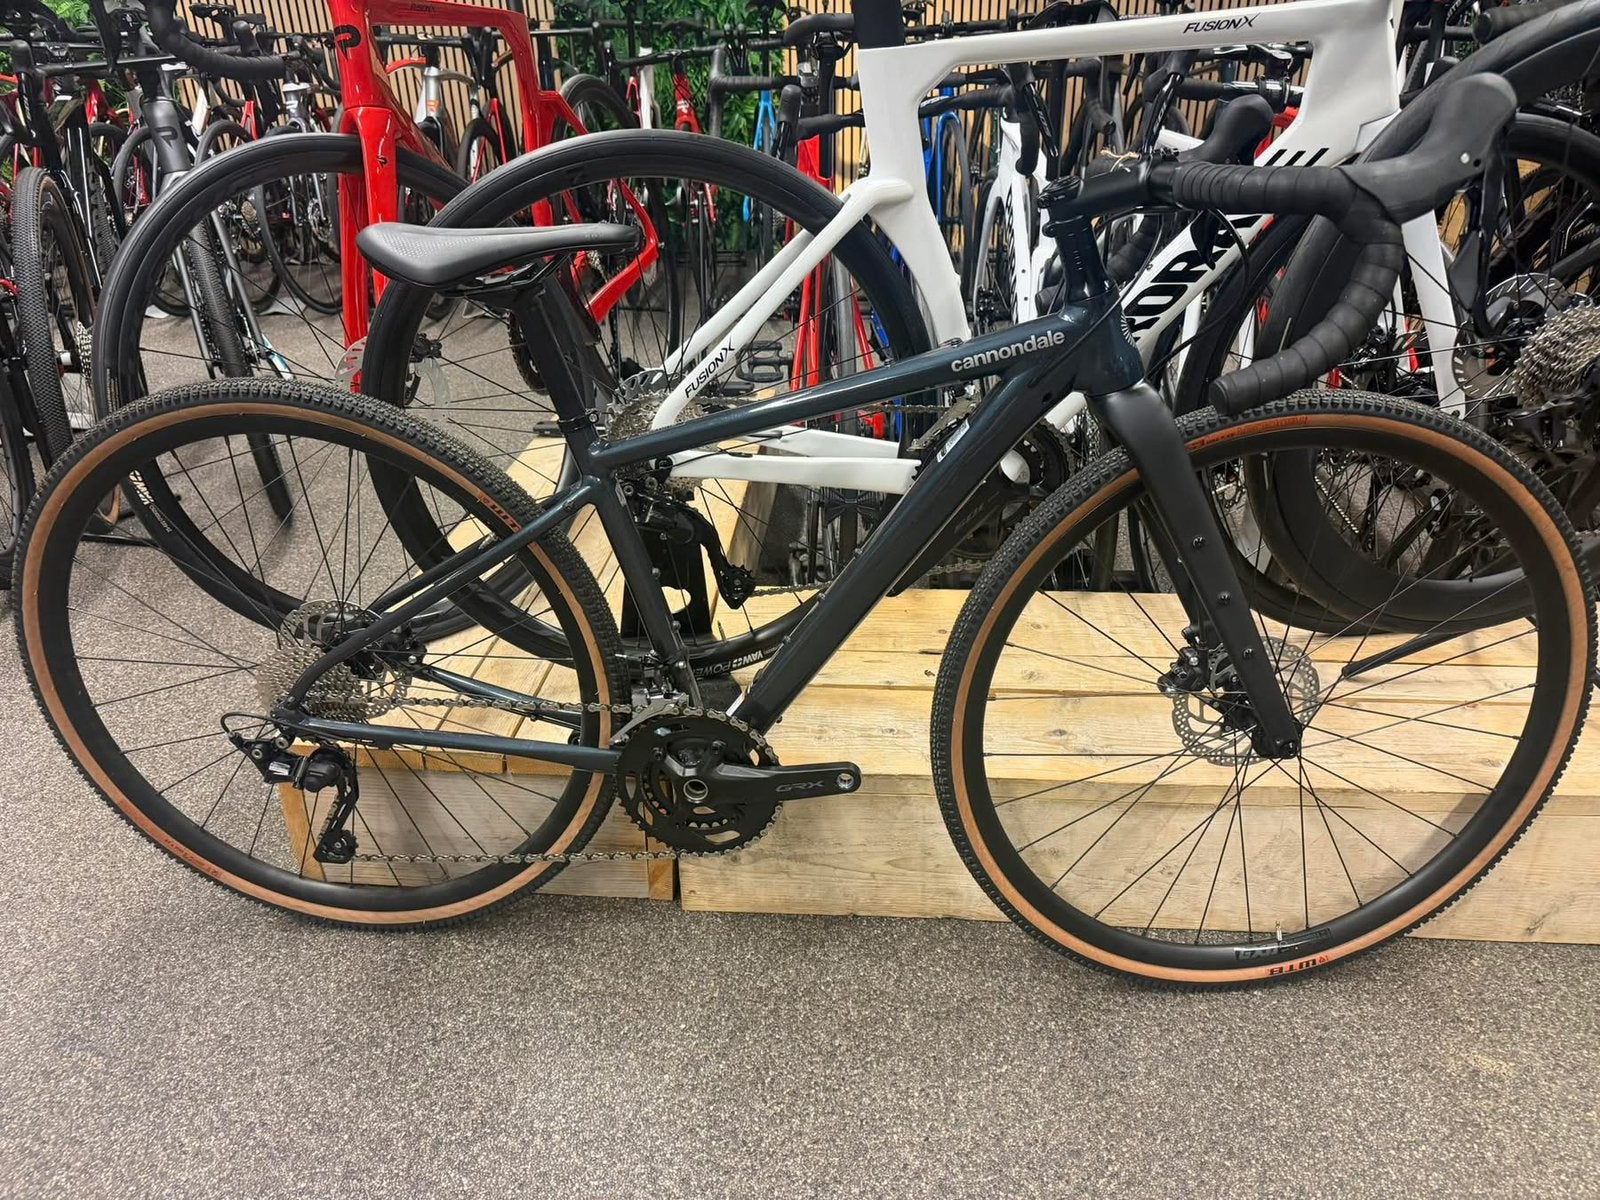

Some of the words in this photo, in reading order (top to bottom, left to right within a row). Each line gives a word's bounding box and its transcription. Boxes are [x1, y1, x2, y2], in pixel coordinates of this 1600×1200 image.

[951, 330, 1066, 373] cannondale
[775, 779, 825, 793] GRX
[1268, 957, 1318, 976] WTB
